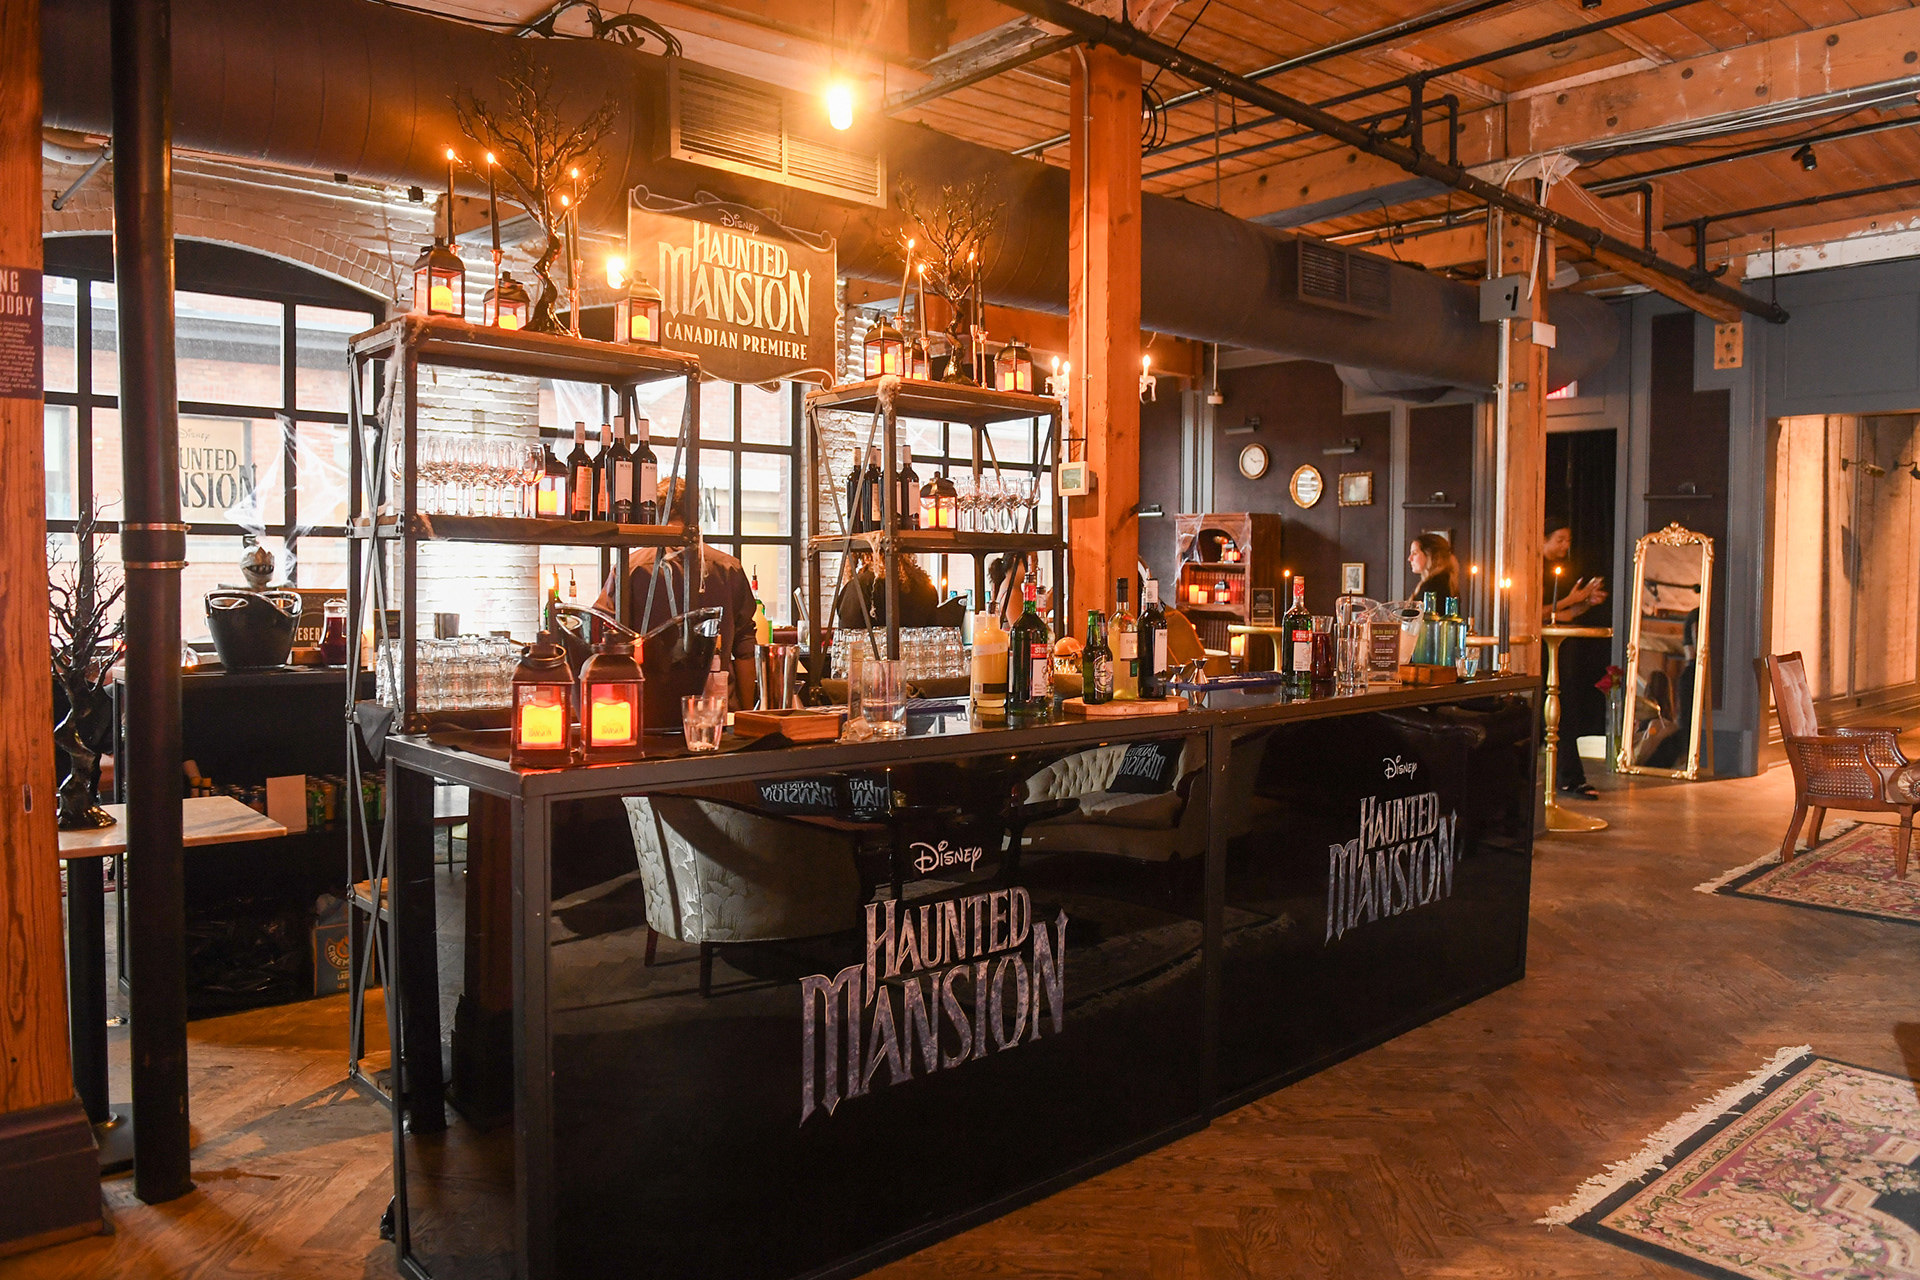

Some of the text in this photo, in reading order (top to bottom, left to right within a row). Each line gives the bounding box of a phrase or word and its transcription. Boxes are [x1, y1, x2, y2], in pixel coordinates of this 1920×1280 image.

[657, 241, 812, 336] MANSION
[692, 220, 789, 279] HAUNTED
[665, 322, 808, 361] CANADIAN PREMIERE
[1323, 807, 1457, 947] MANSION
[1358, 791, 1440, 870] HAUNTED
[864, 886, 1030, 1007] HAUNTED
[798, 909, 1069, 1129] MANSION
